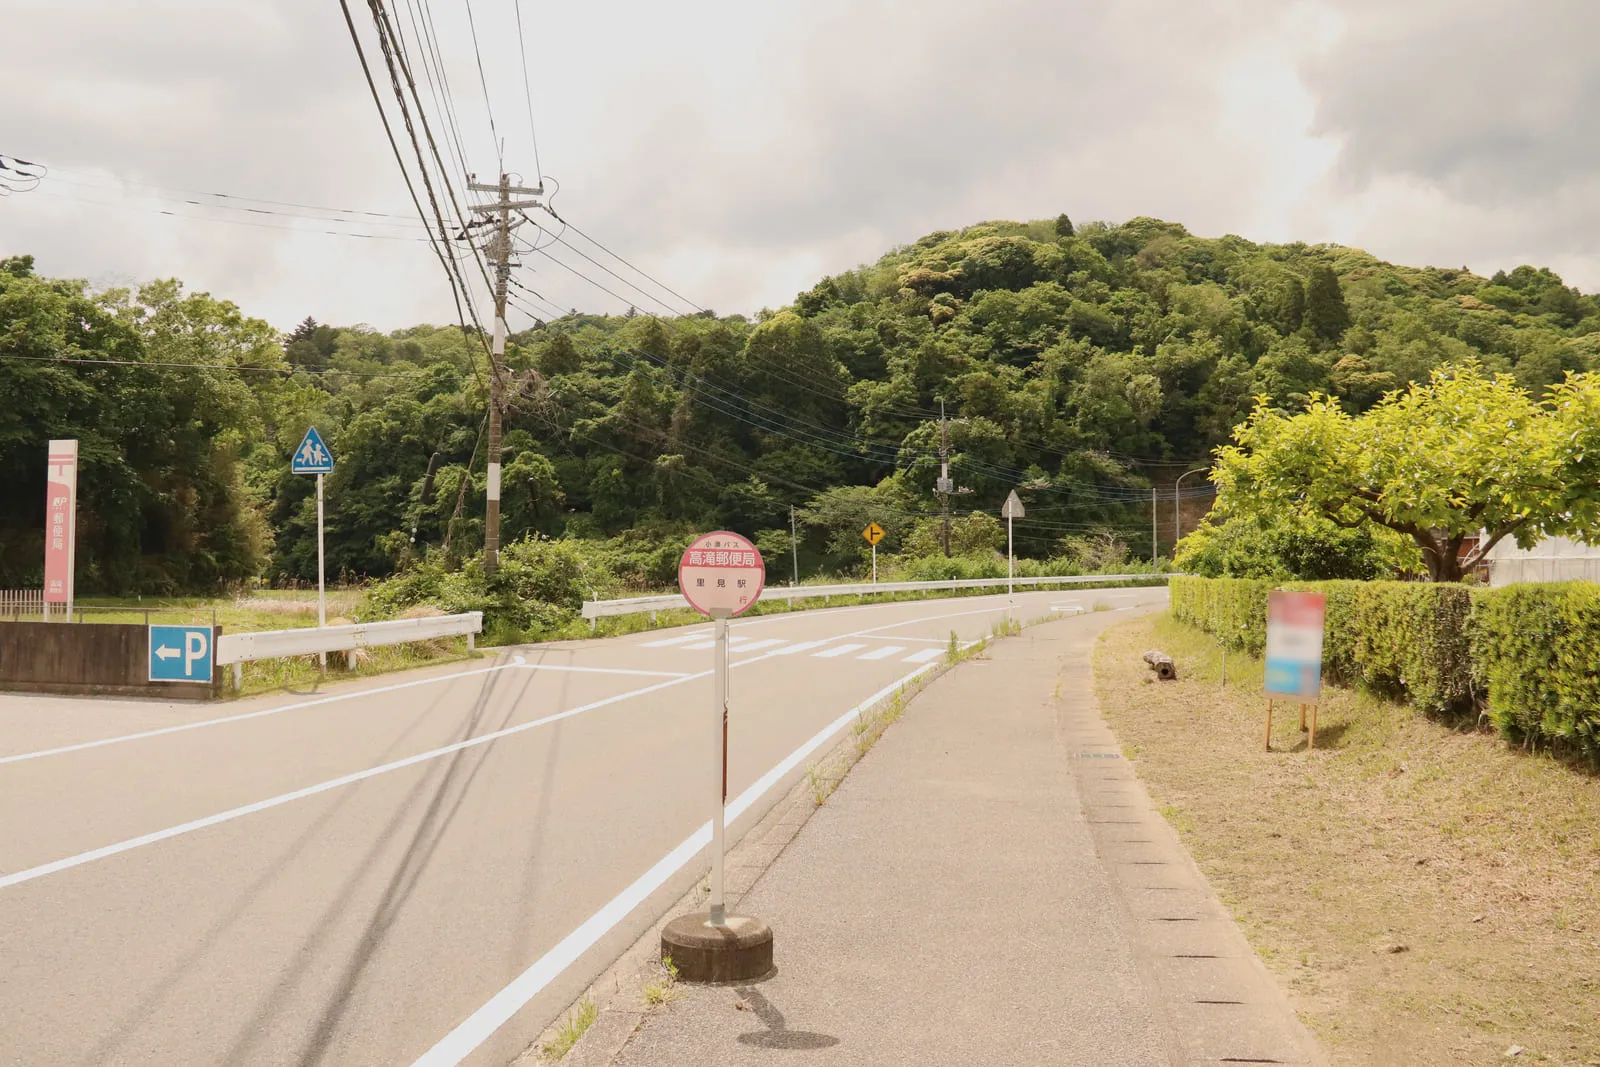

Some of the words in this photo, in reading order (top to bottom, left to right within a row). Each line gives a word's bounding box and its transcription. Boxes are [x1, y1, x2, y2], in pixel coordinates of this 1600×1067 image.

[52, 512, 64, 550] 郵便局
[185, 631, 207, 676] P
